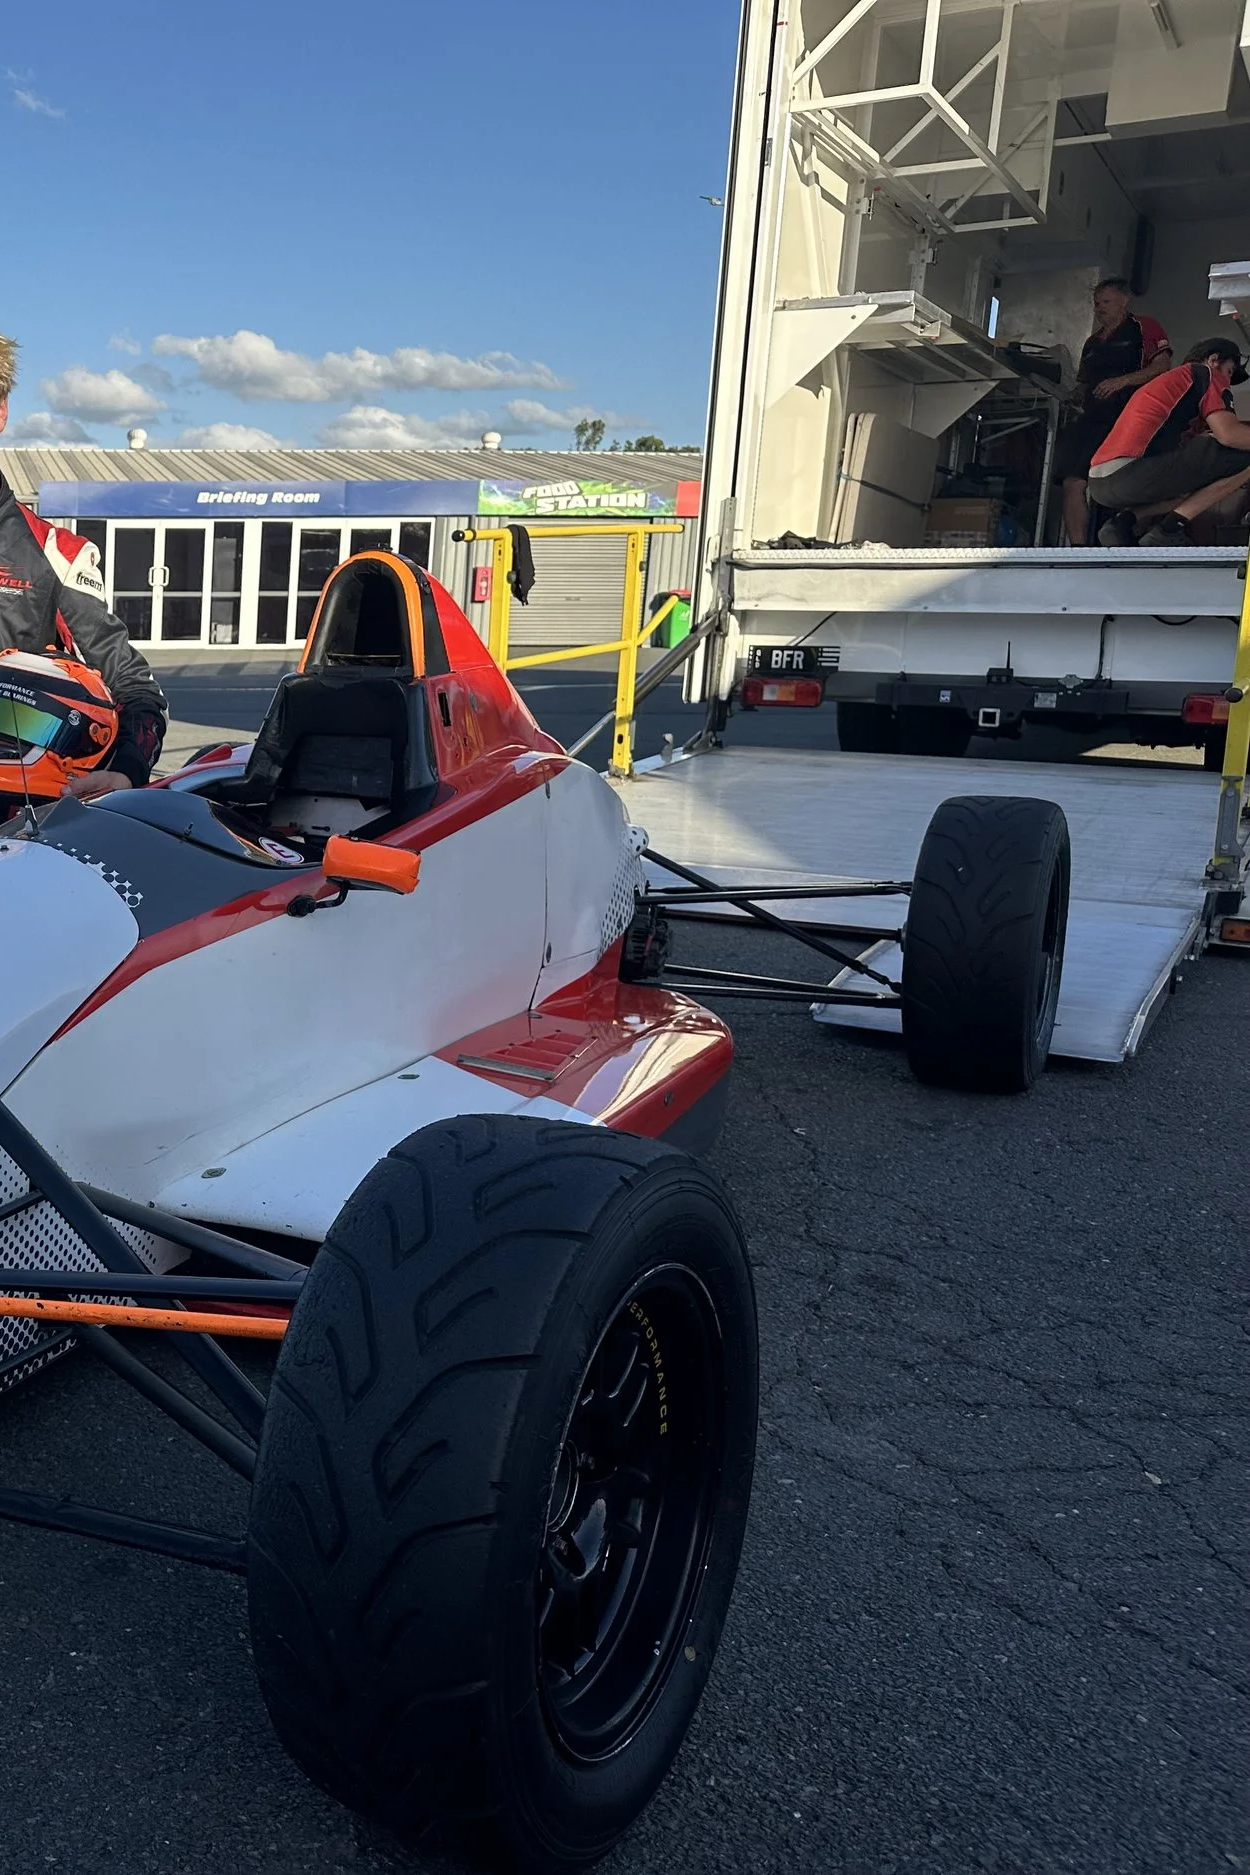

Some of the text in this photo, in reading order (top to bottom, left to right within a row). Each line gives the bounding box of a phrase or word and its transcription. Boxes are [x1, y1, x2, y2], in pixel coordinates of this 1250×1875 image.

[196, 491, 320, 505] Briefing Room
[522, 480, 581, 499] FOOD
[534, 492, 647, 515] STATION
[76, 571, 103, 592] freem
[771, 649, 805, 669] BFR
